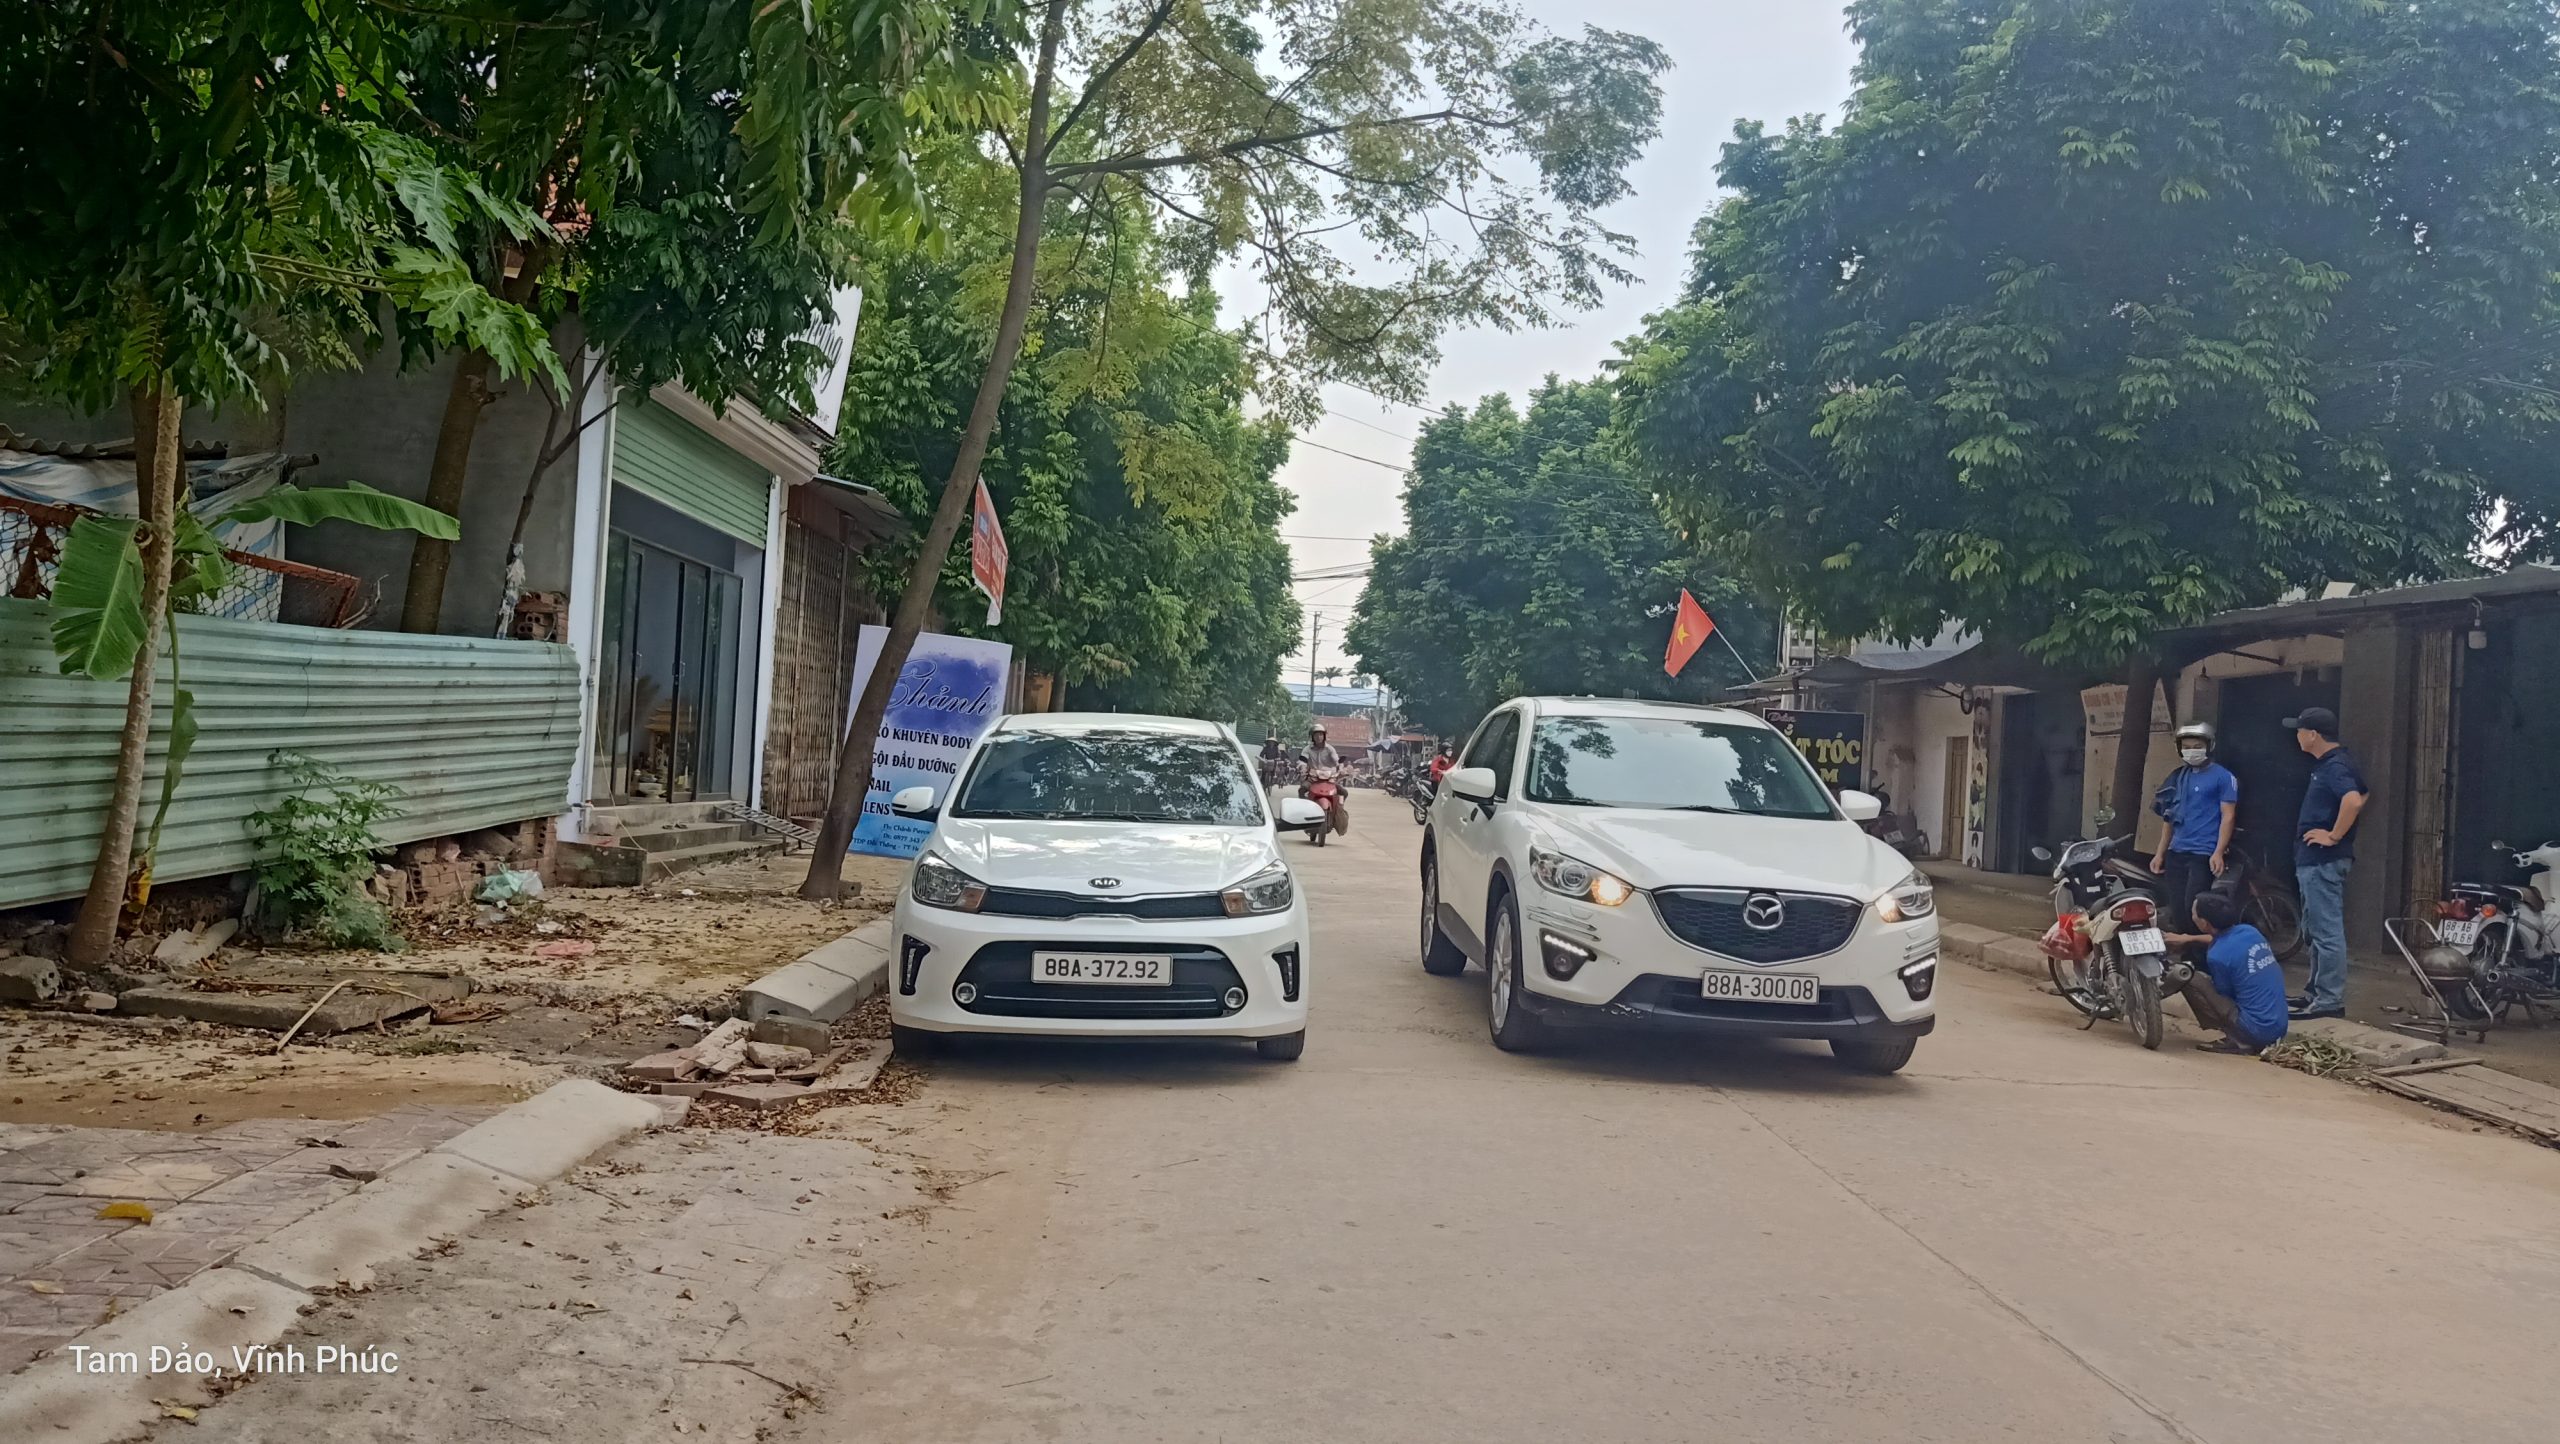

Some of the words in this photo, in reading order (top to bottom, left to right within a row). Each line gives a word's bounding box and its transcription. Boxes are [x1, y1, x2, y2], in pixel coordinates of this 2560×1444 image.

[892, 728, 939, 745] KHUYÊN
[941, 734, 973, 750] BODY
[1815, 731, 1861, 765] TÓC
[892, 750, 915, 769] ĐẦU
[917, 757, 957, 775] DƯỠNG
[863, 801, 890, 815] LENS
[1045, 958, 1159, 979] 88A-372.92
[1707, 974, 1814, 1000] 88A-300.08
